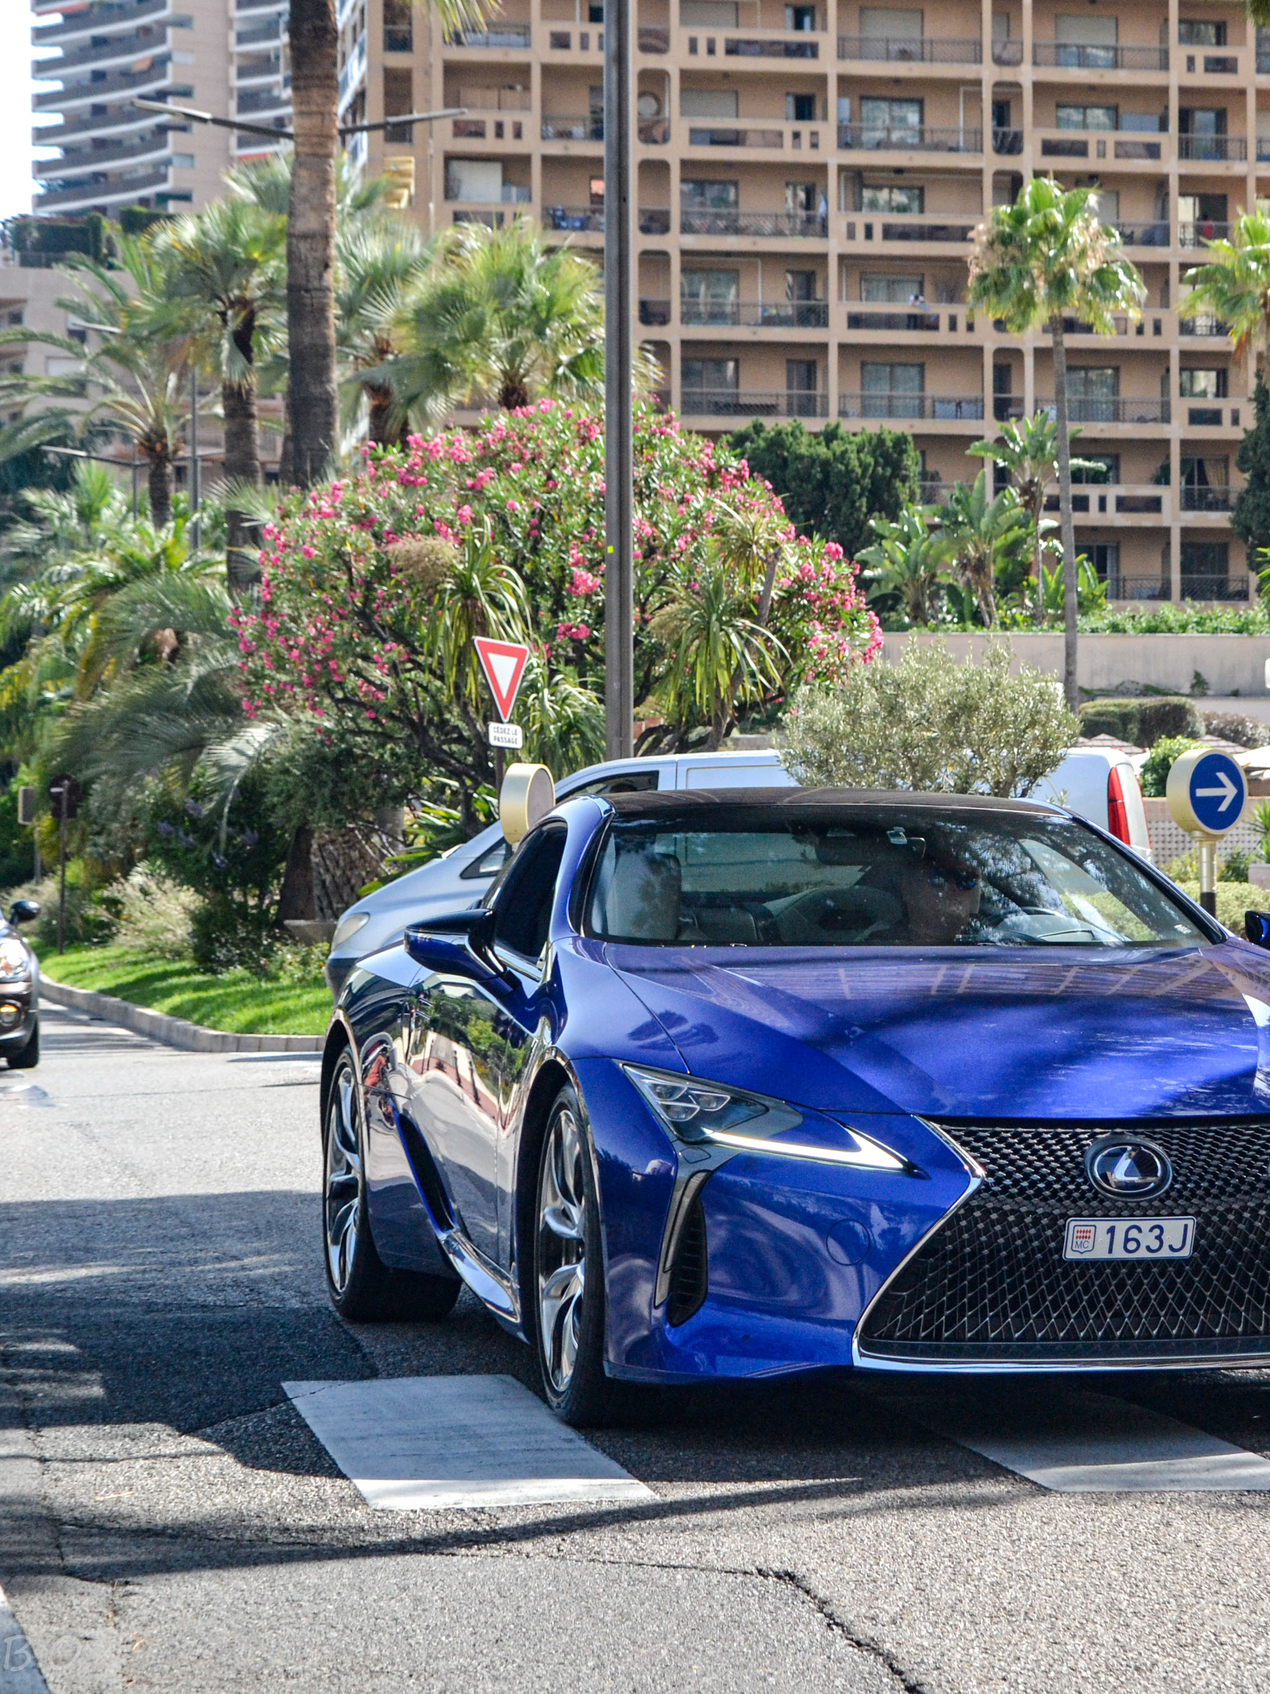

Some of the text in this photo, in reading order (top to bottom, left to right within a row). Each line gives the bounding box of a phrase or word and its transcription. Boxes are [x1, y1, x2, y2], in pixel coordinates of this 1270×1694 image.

[493, 735, 518, 745] PASSAGE
[1106, 1223, 1189, 1255] 163J
[1074, 1240, 1090, 1250] MC
